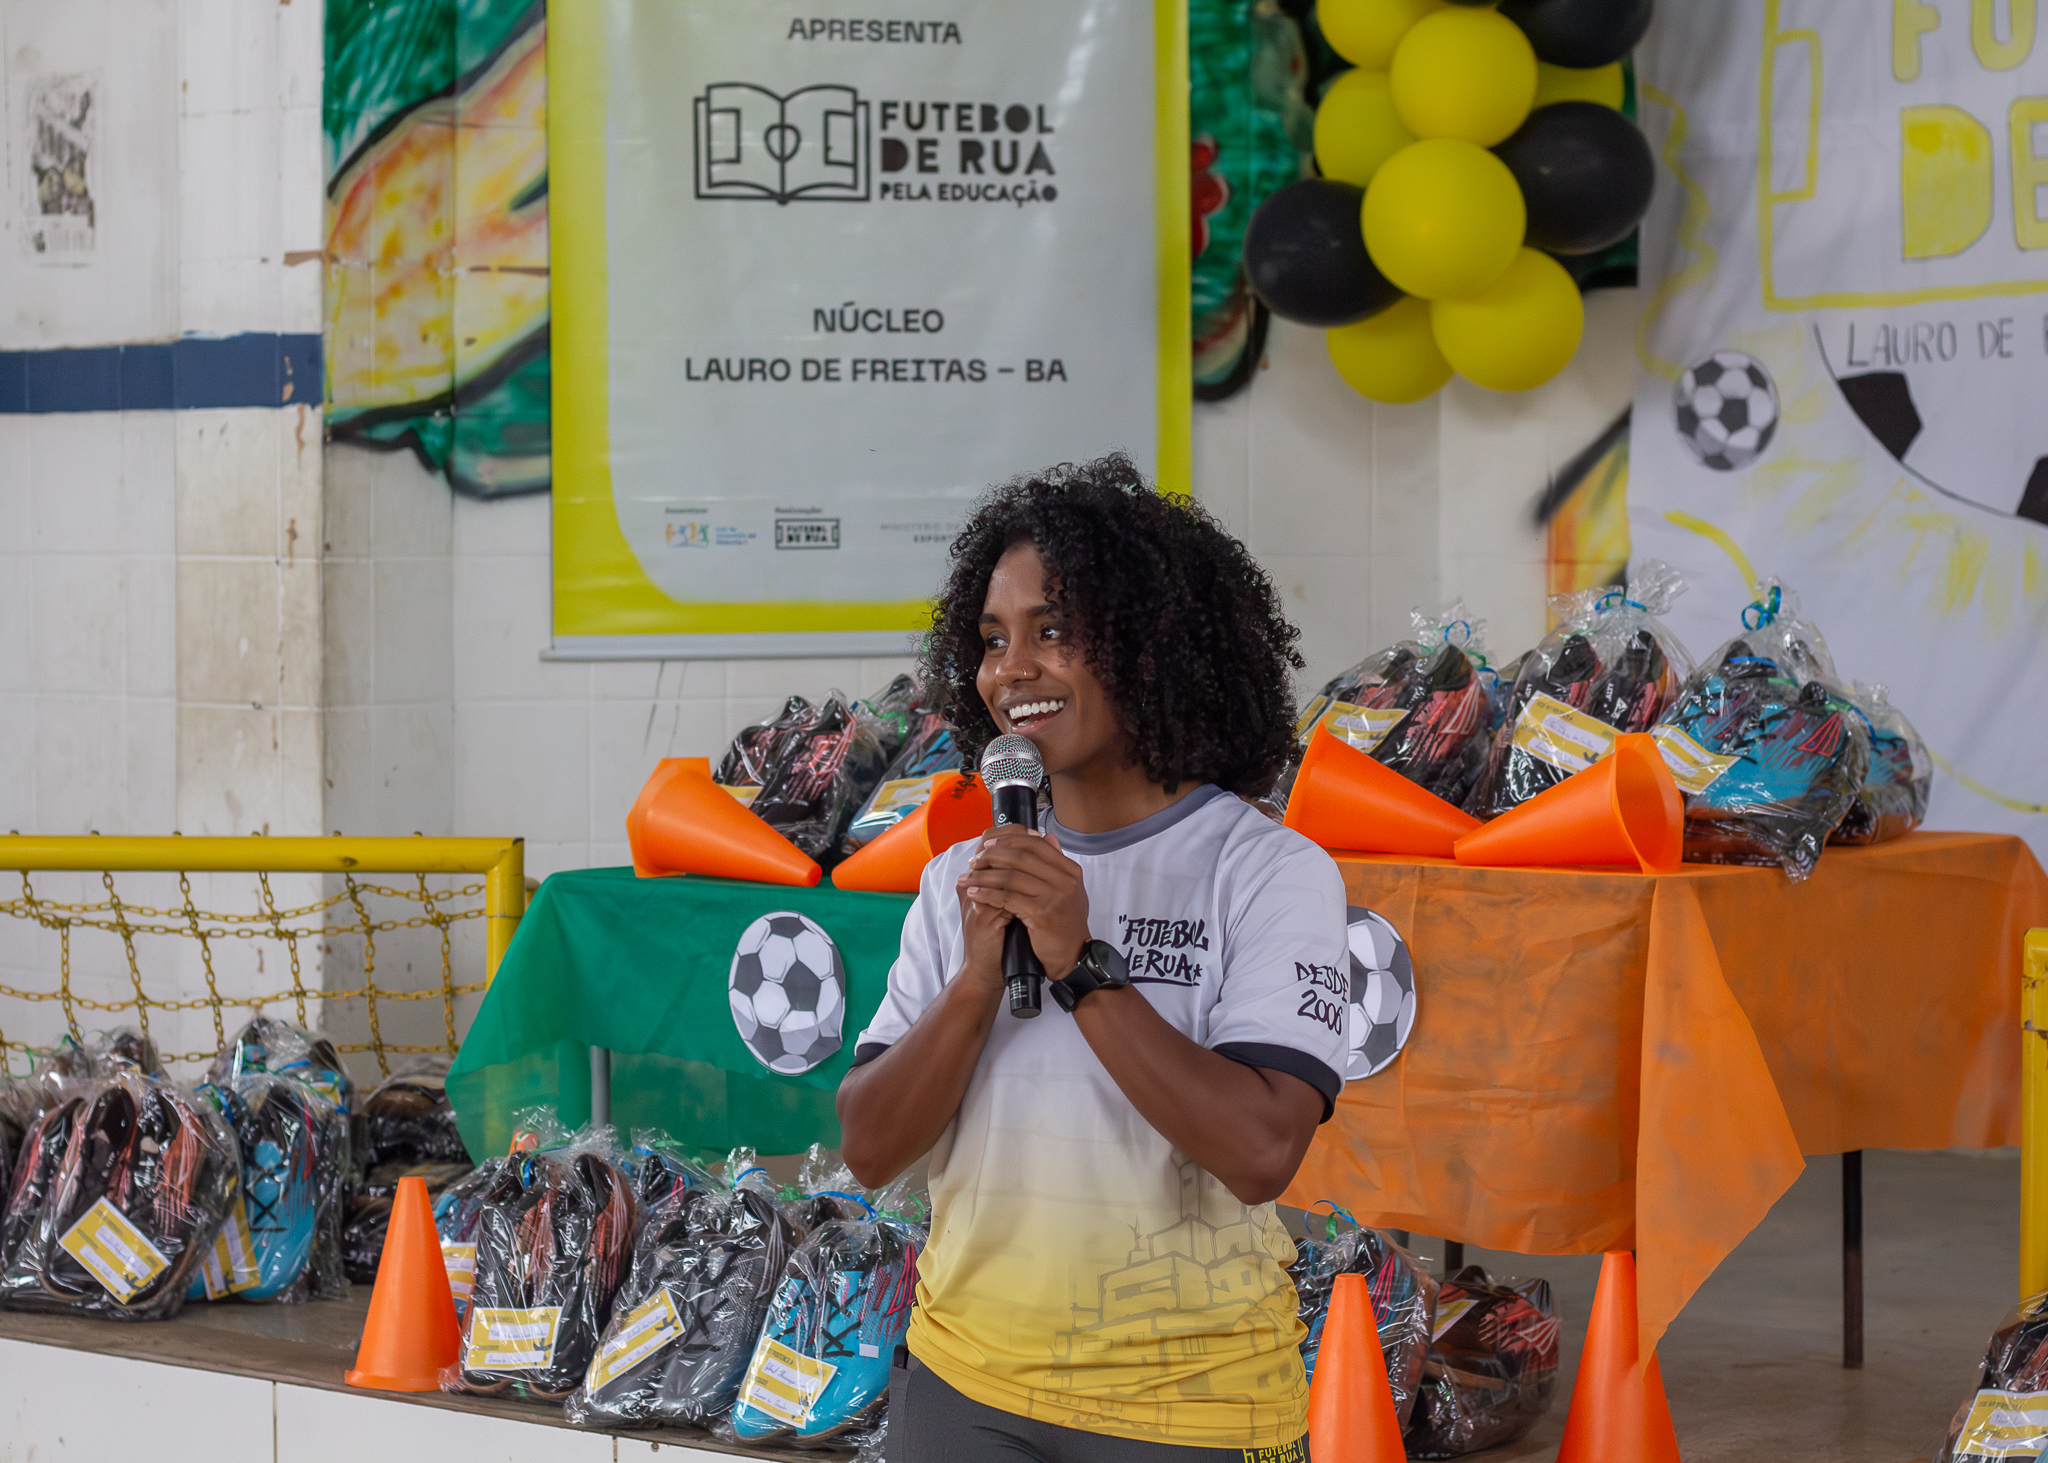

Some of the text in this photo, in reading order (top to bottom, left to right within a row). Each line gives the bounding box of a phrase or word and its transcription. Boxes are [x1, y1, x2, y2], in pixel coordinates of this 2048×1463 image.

[787, 18, 963, 44] APRESENTA
[880, 101, 1055, 134] FUTEBOL
[880, 137, 1056, 176] DE RUA
[880, 179, 1057, 209] PELA EDUCAÇÃO
[1901, 98, 2048, 262] DE
[813, 301, 945, 333] NÚCLEO
[1847, 317, 1958, 368] LAURO
[1977, 316, 2015, 361] DE
[685, 357, 791, 382] LAURO
[801, 358, 841, 382] DE
[851, 358, 987, 383] FREITAS
[1025, 358, 1068, 383] BA
[1294, 962, 1349, 1003] DESDE
